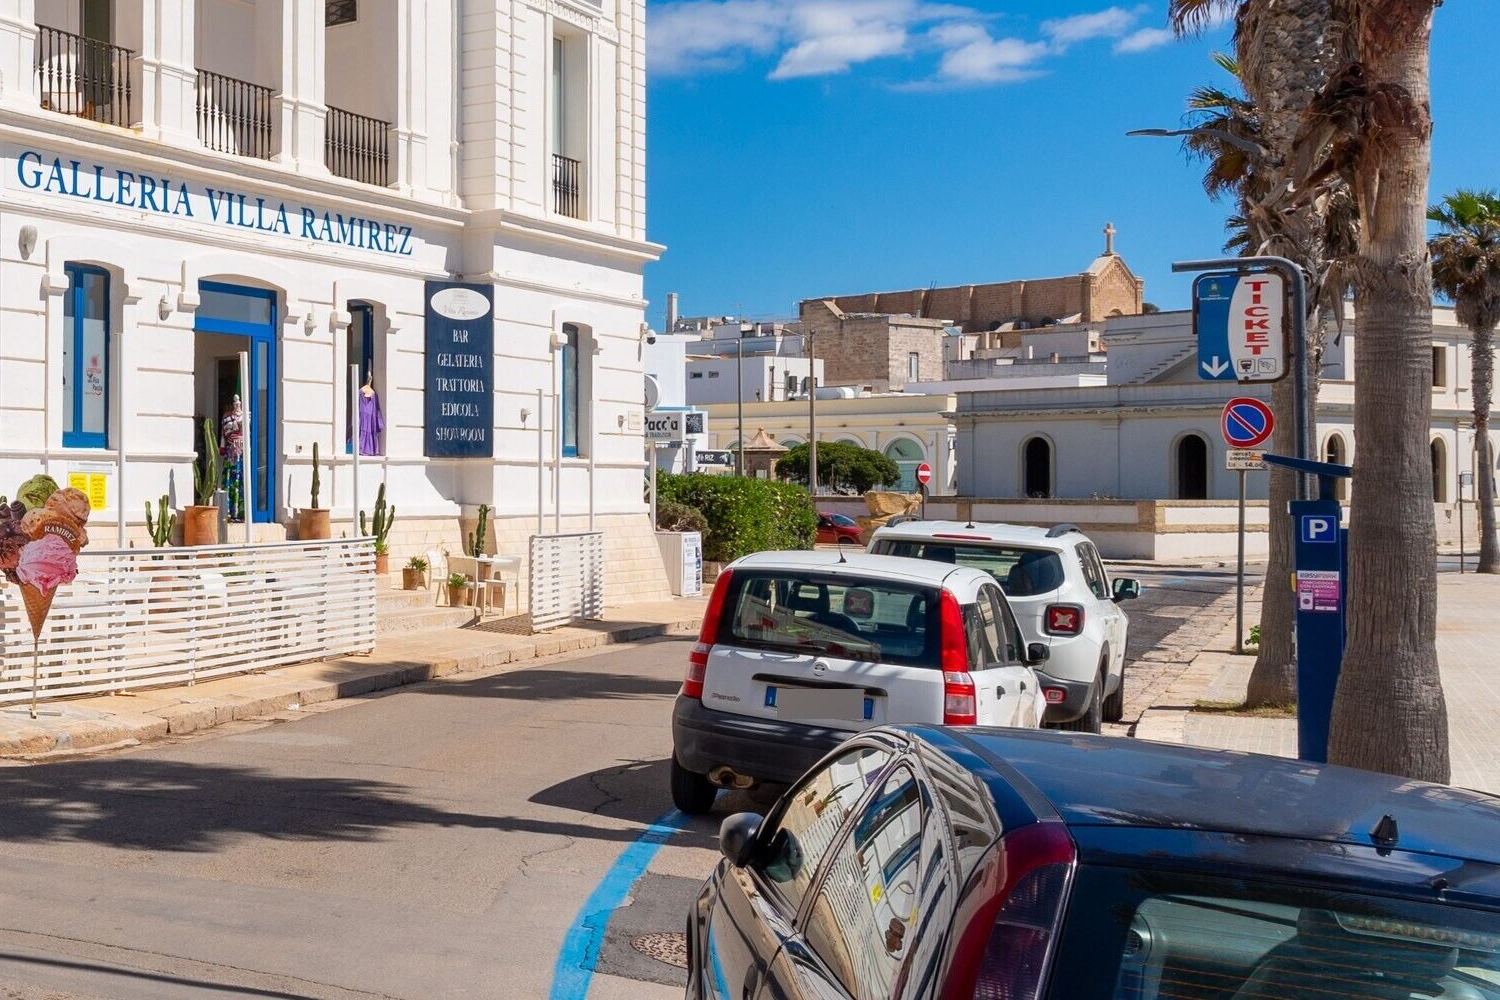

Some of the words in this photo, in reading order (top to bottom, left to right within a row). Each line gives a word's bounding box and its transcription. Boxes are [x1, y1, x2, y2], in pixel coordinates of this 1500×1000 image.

[17, 151, 194, 217] GALLERIA
[205, 187, 291, 235] VILLA
[301, 207, 413, 256] RAMIREZ
[1244, 281, 1270, 355] TICKET
[452, 329, 469, 343] BAR
[437, 353, 483, 368] GELATERIA
[436, 378, 485, 393] TRATTORIA
[441, 402, 480, 417] EDICOLA
[435, 427, 485, 441] SHOWROOM
[44, 525, 76, 542] RAMIREZ
[1309, 519, 1329, 539] P
